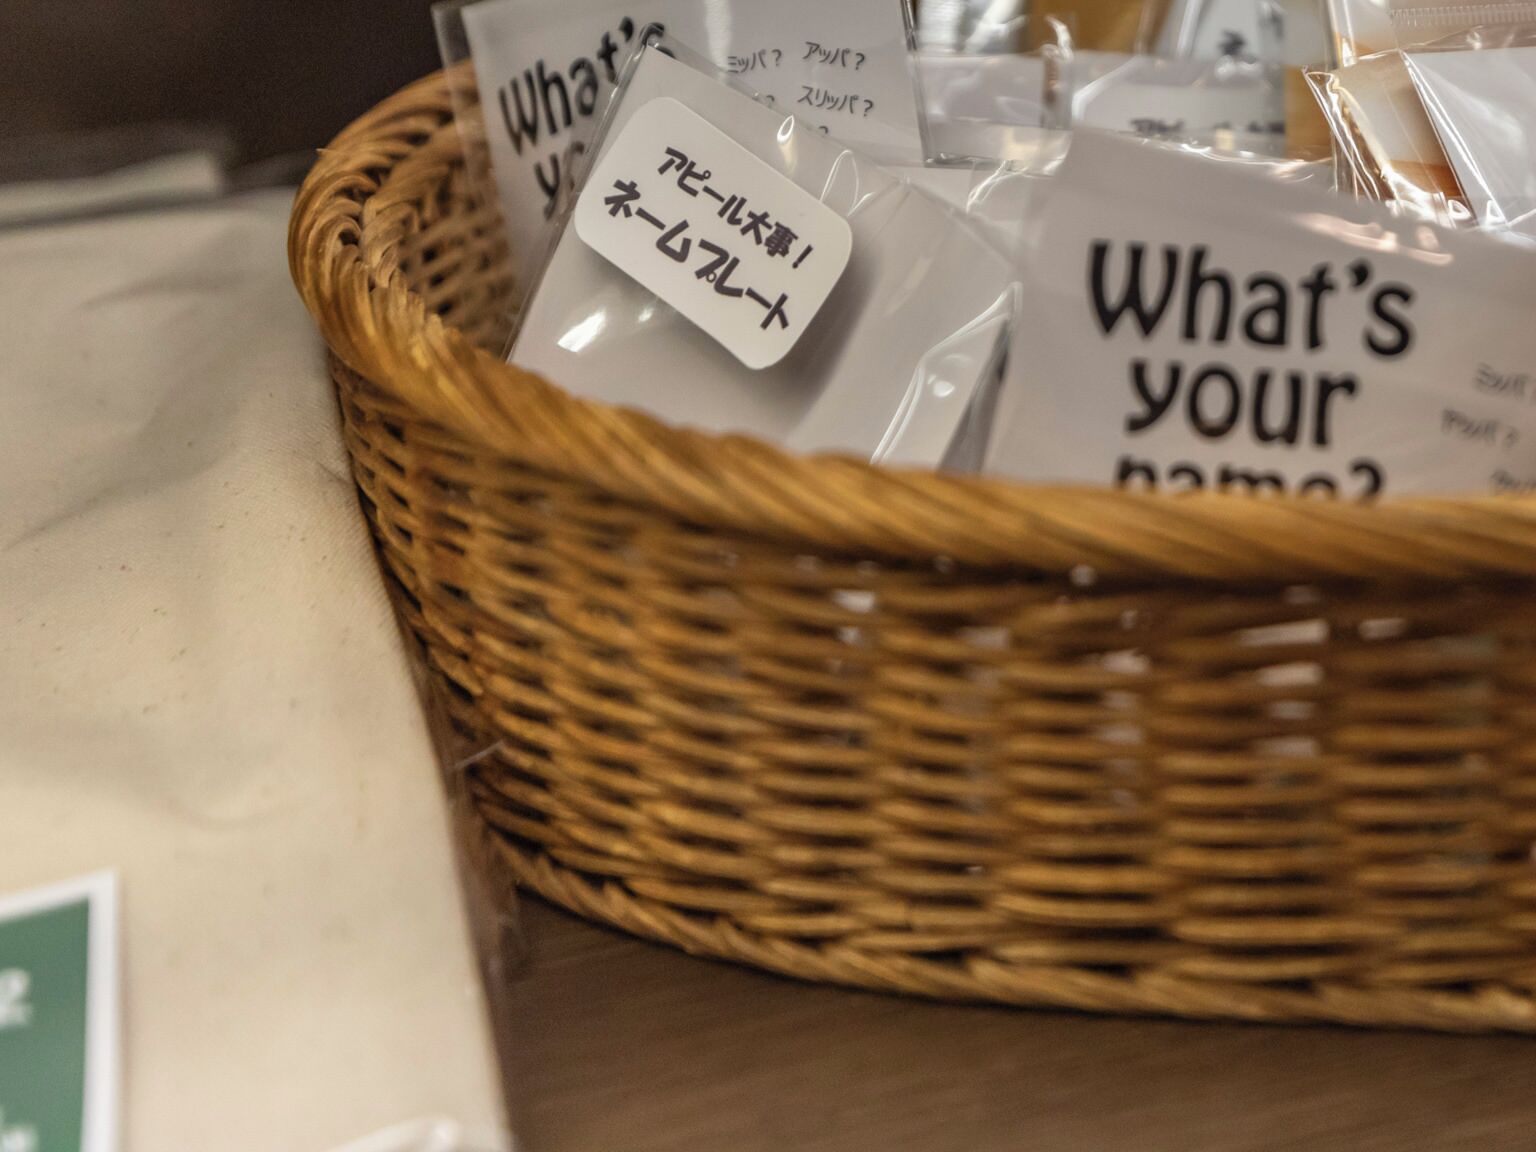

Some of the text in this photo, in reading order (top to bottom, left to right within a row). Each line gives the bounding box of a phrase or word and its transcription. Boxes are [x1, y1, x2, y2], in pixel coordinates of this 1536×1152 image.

[797, 85, 875, 117] スリッパ？
[803, 41, 866, 70] アッパ？
[603, 179, 789, 330] ネームプレート
[657, 146, 814, 269] アピール大事！
[1088, 239, 1417, 356] What's
[1123, 358, 1359, 448] your
